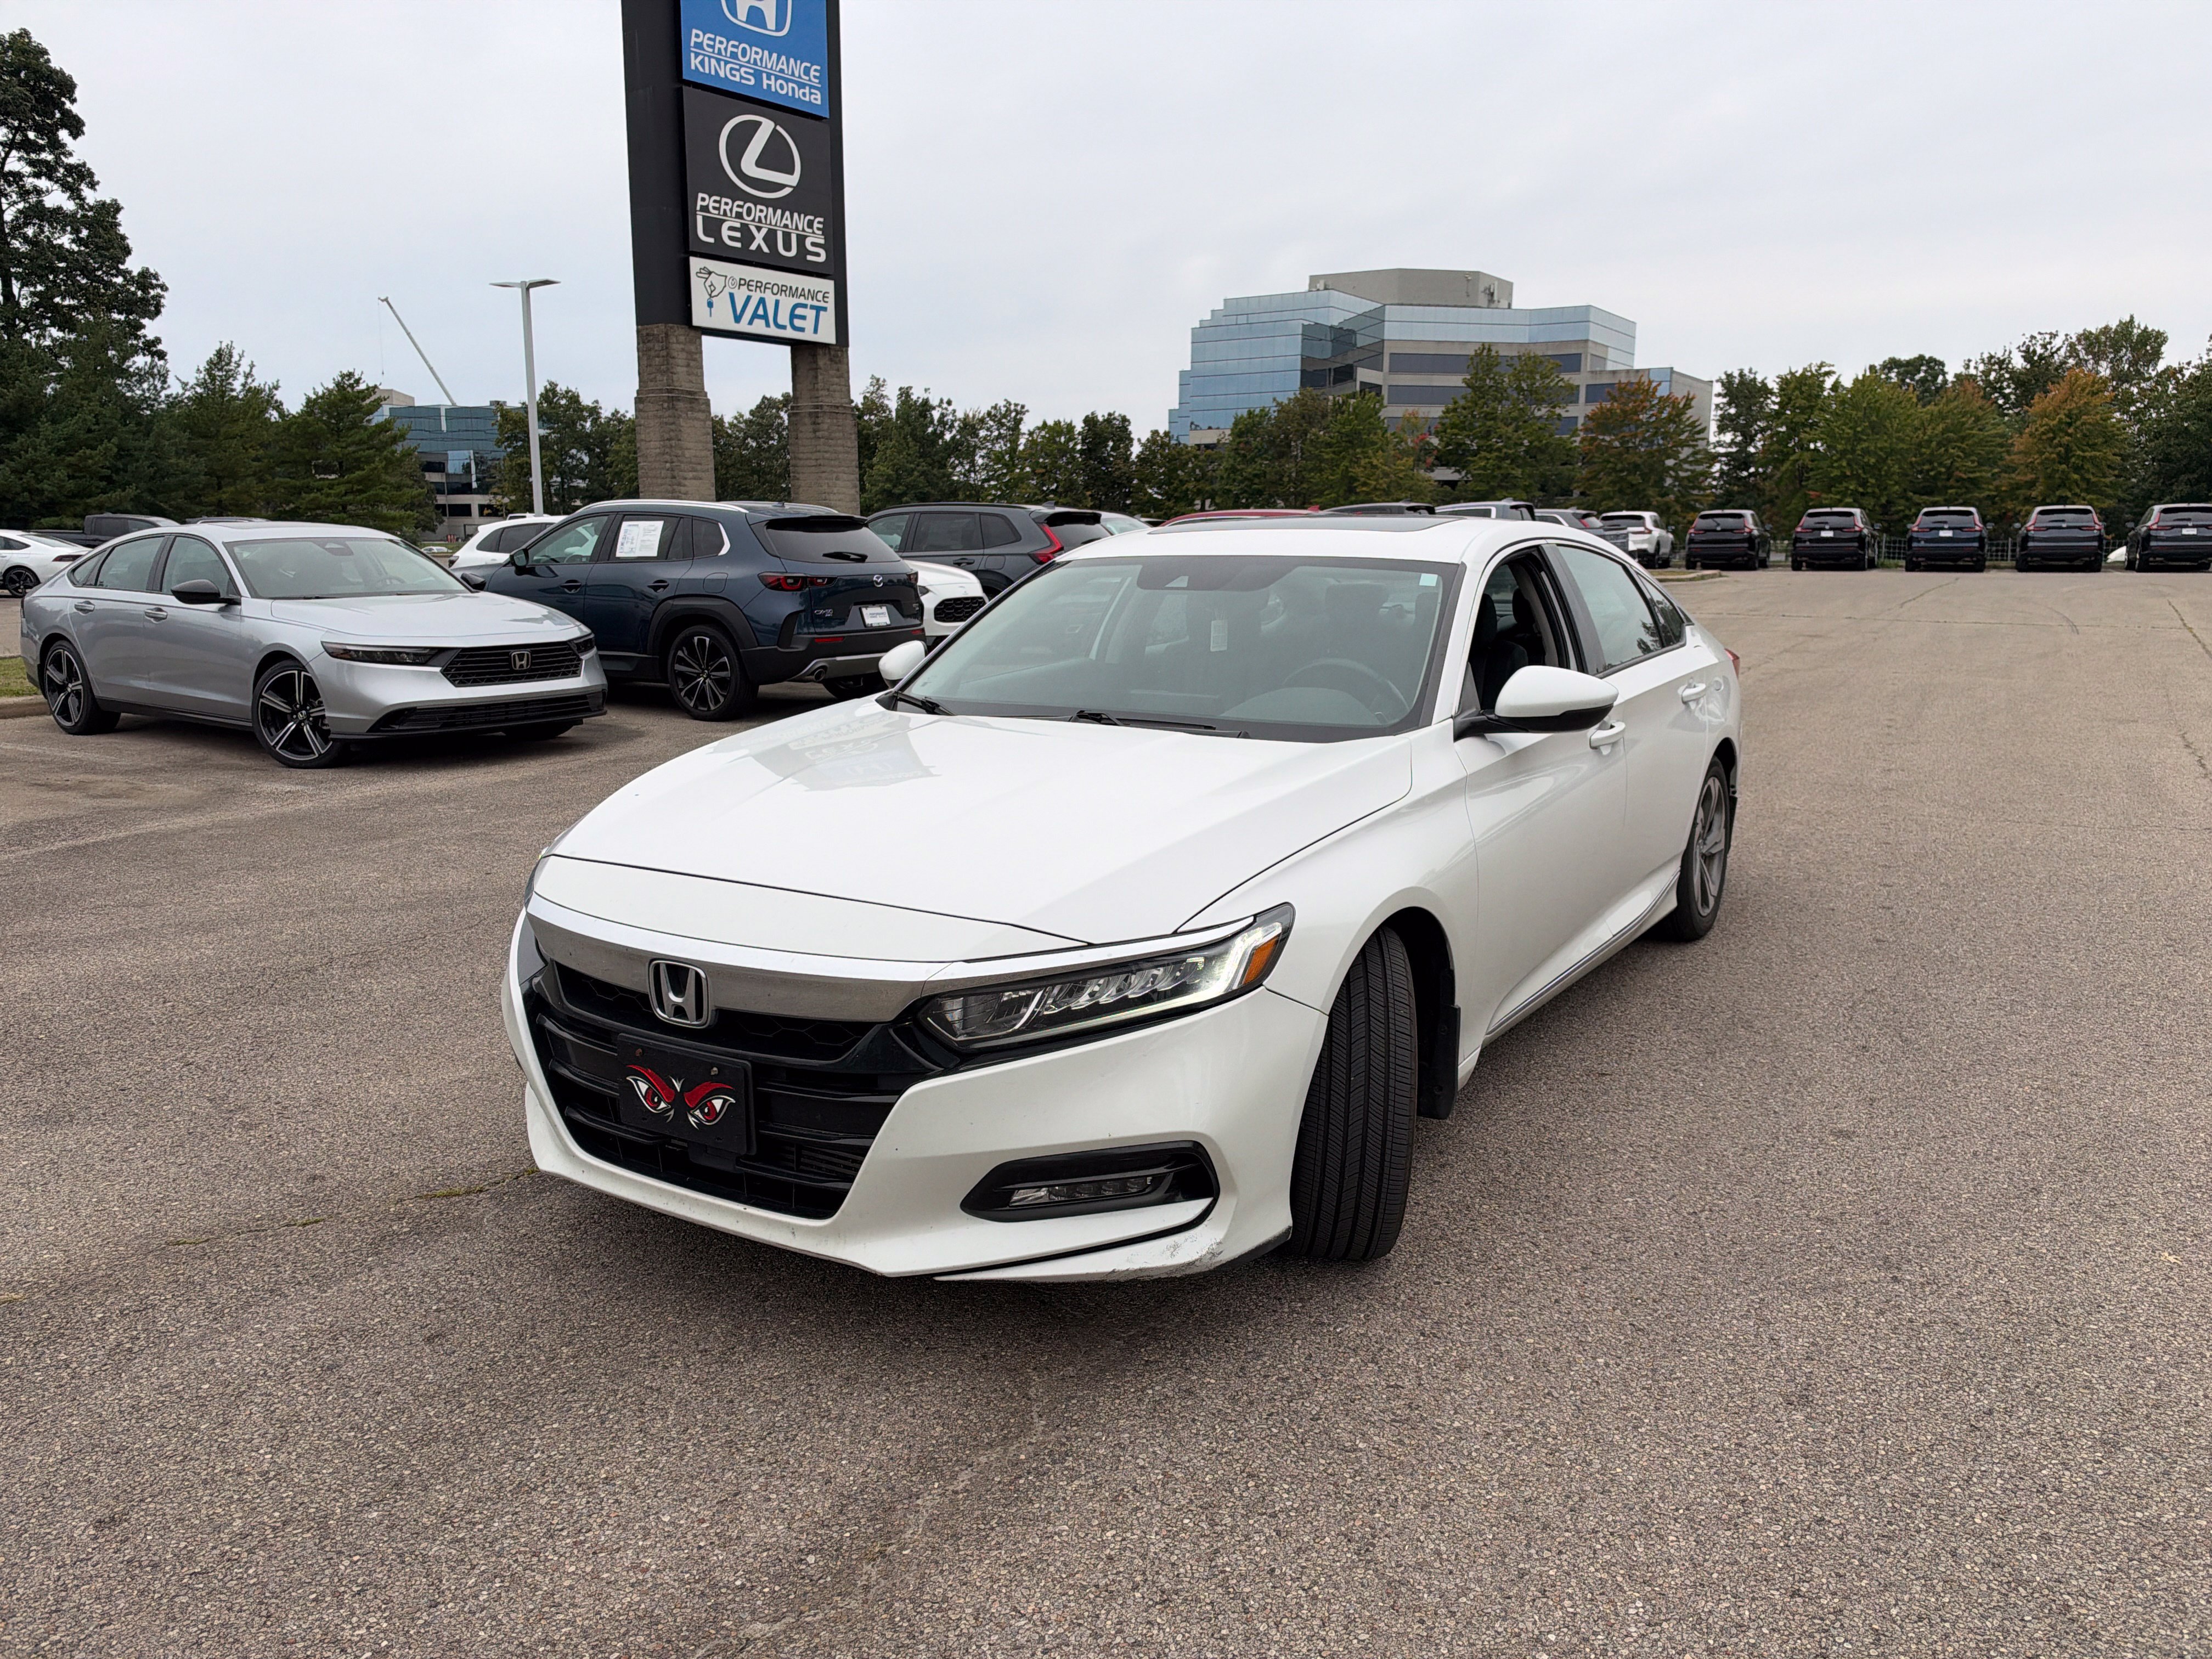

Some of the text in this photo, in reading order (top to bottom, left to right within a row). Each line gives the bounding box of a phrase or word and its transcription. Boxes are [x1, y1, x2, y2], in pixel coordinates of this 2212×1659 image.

[690, 28, 821, 83] PERFORMANCE
[690, 53, 822, 105] KINGS Honda
[696, 192, 824, 235] PERFORMANCE
[696, 215, 826, 263] LEXUS
[728, 291, 828, 335] VALET
[737, 278, 830, 304] PERFORMANCE
